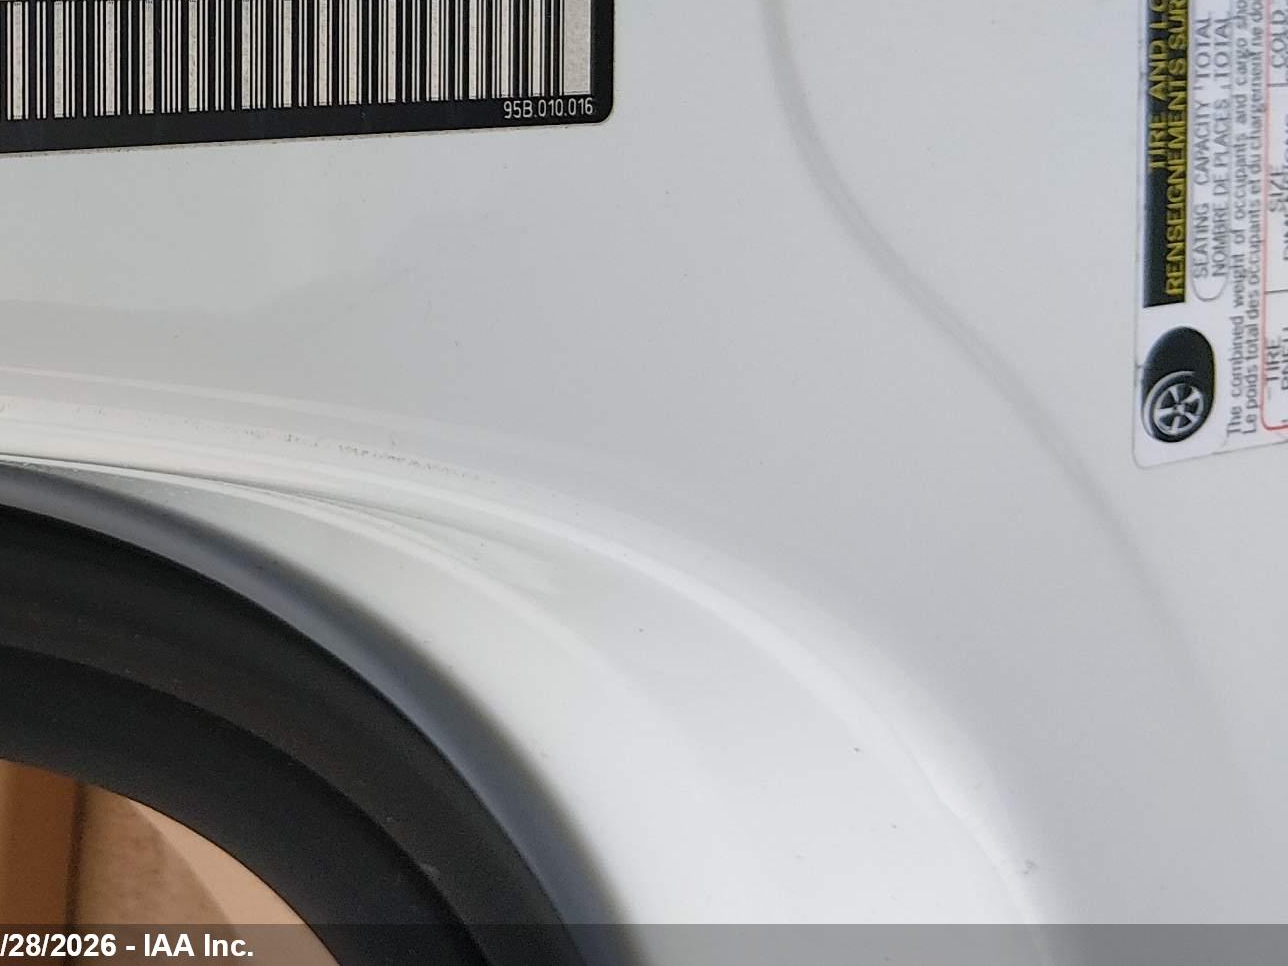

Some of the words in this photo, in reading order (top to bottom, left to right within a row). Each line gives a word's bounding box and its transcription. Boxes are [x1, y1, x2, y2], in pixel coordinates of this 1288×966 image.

[1148, 39, 1167, 100] AND
[502, 97, 594, 120] 95B.010.016
[1148, 112, 1166, 172] TIRE
